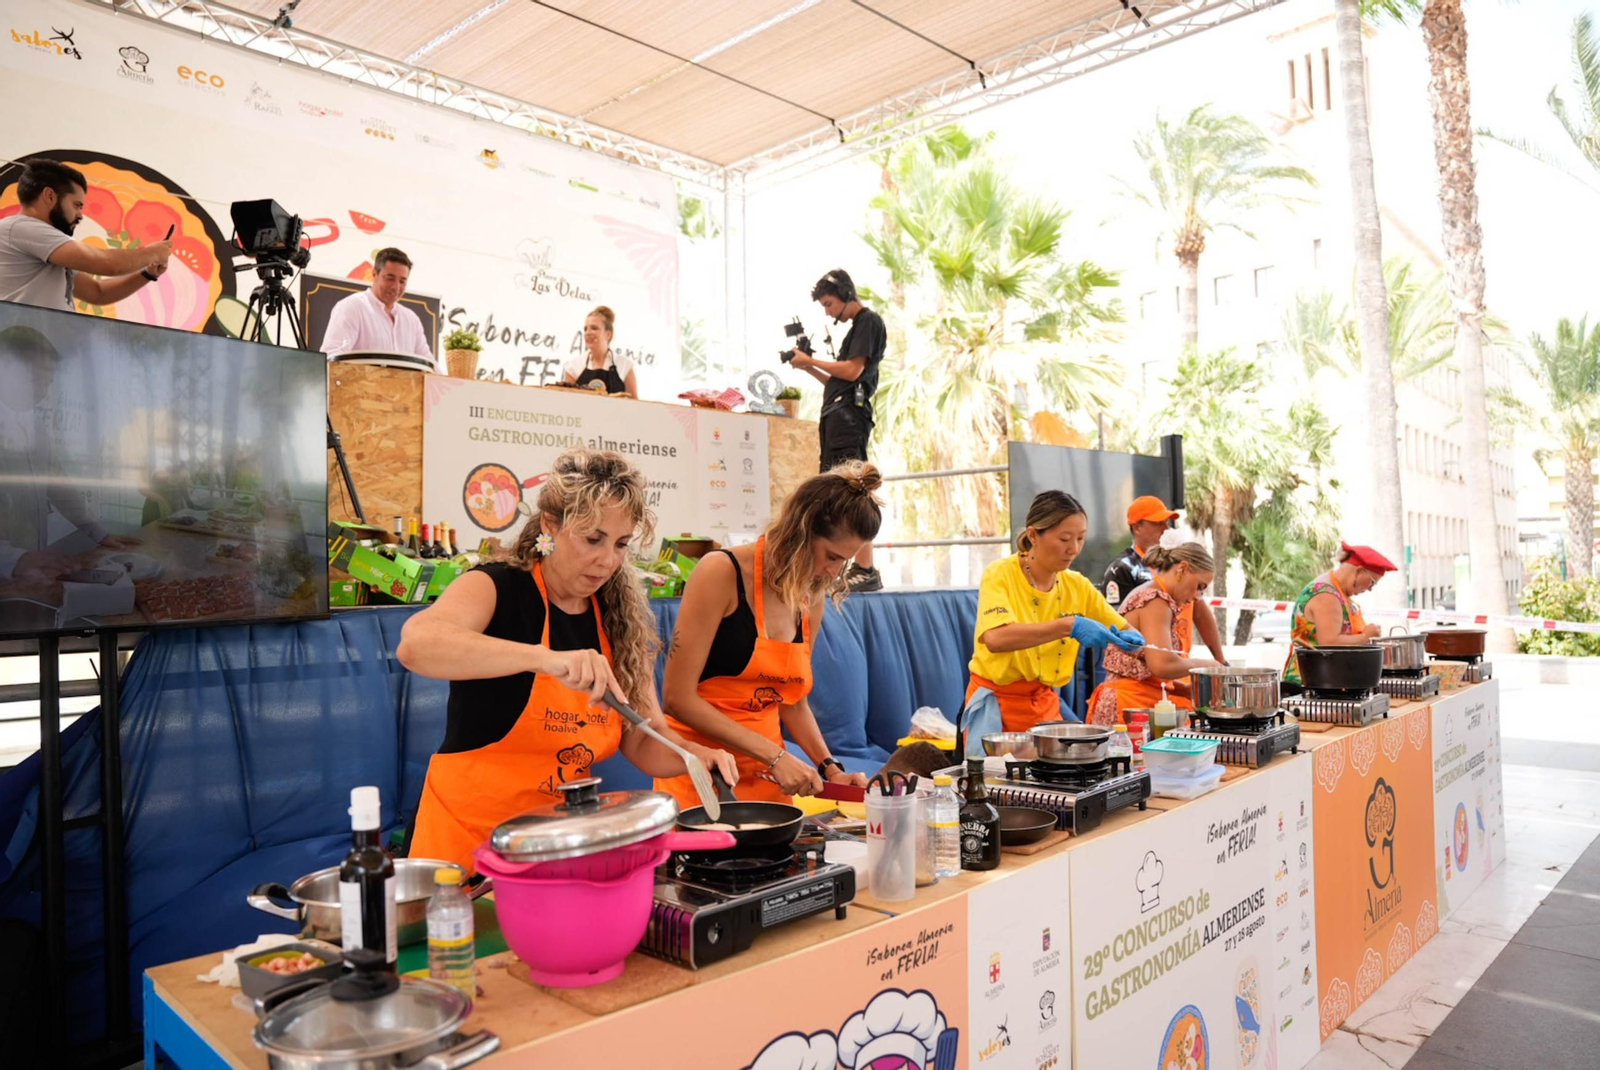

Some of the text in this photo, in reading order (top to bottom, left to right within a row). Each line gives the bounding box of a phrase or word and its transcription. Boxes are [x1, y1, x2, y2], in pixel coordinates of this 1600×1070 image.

[177, 65, 225, 88] eco
[530, 275, 550, 295] Las
[469, 405, 582, 427] III ENCUENTRO DE
[468, 426, 677, 457] GASTRONOMÍA almeriense
[545, 707, 608, 724] hogar hotel
[1217, 822, 1256, 864] en FERIA!
[866, 922, 954, 966] ¡Saborea Almería
[1083, 888, 1210, 980] 29º CONCURSO de
[1224, 937, 1231, 951] 27
[1246, 915, 1265, 937] agosto
[881, 940, 939, 981] en FERIA!
[1085, 887, 1265, 1020] GASTRONOMÍA ALMERIENSE
